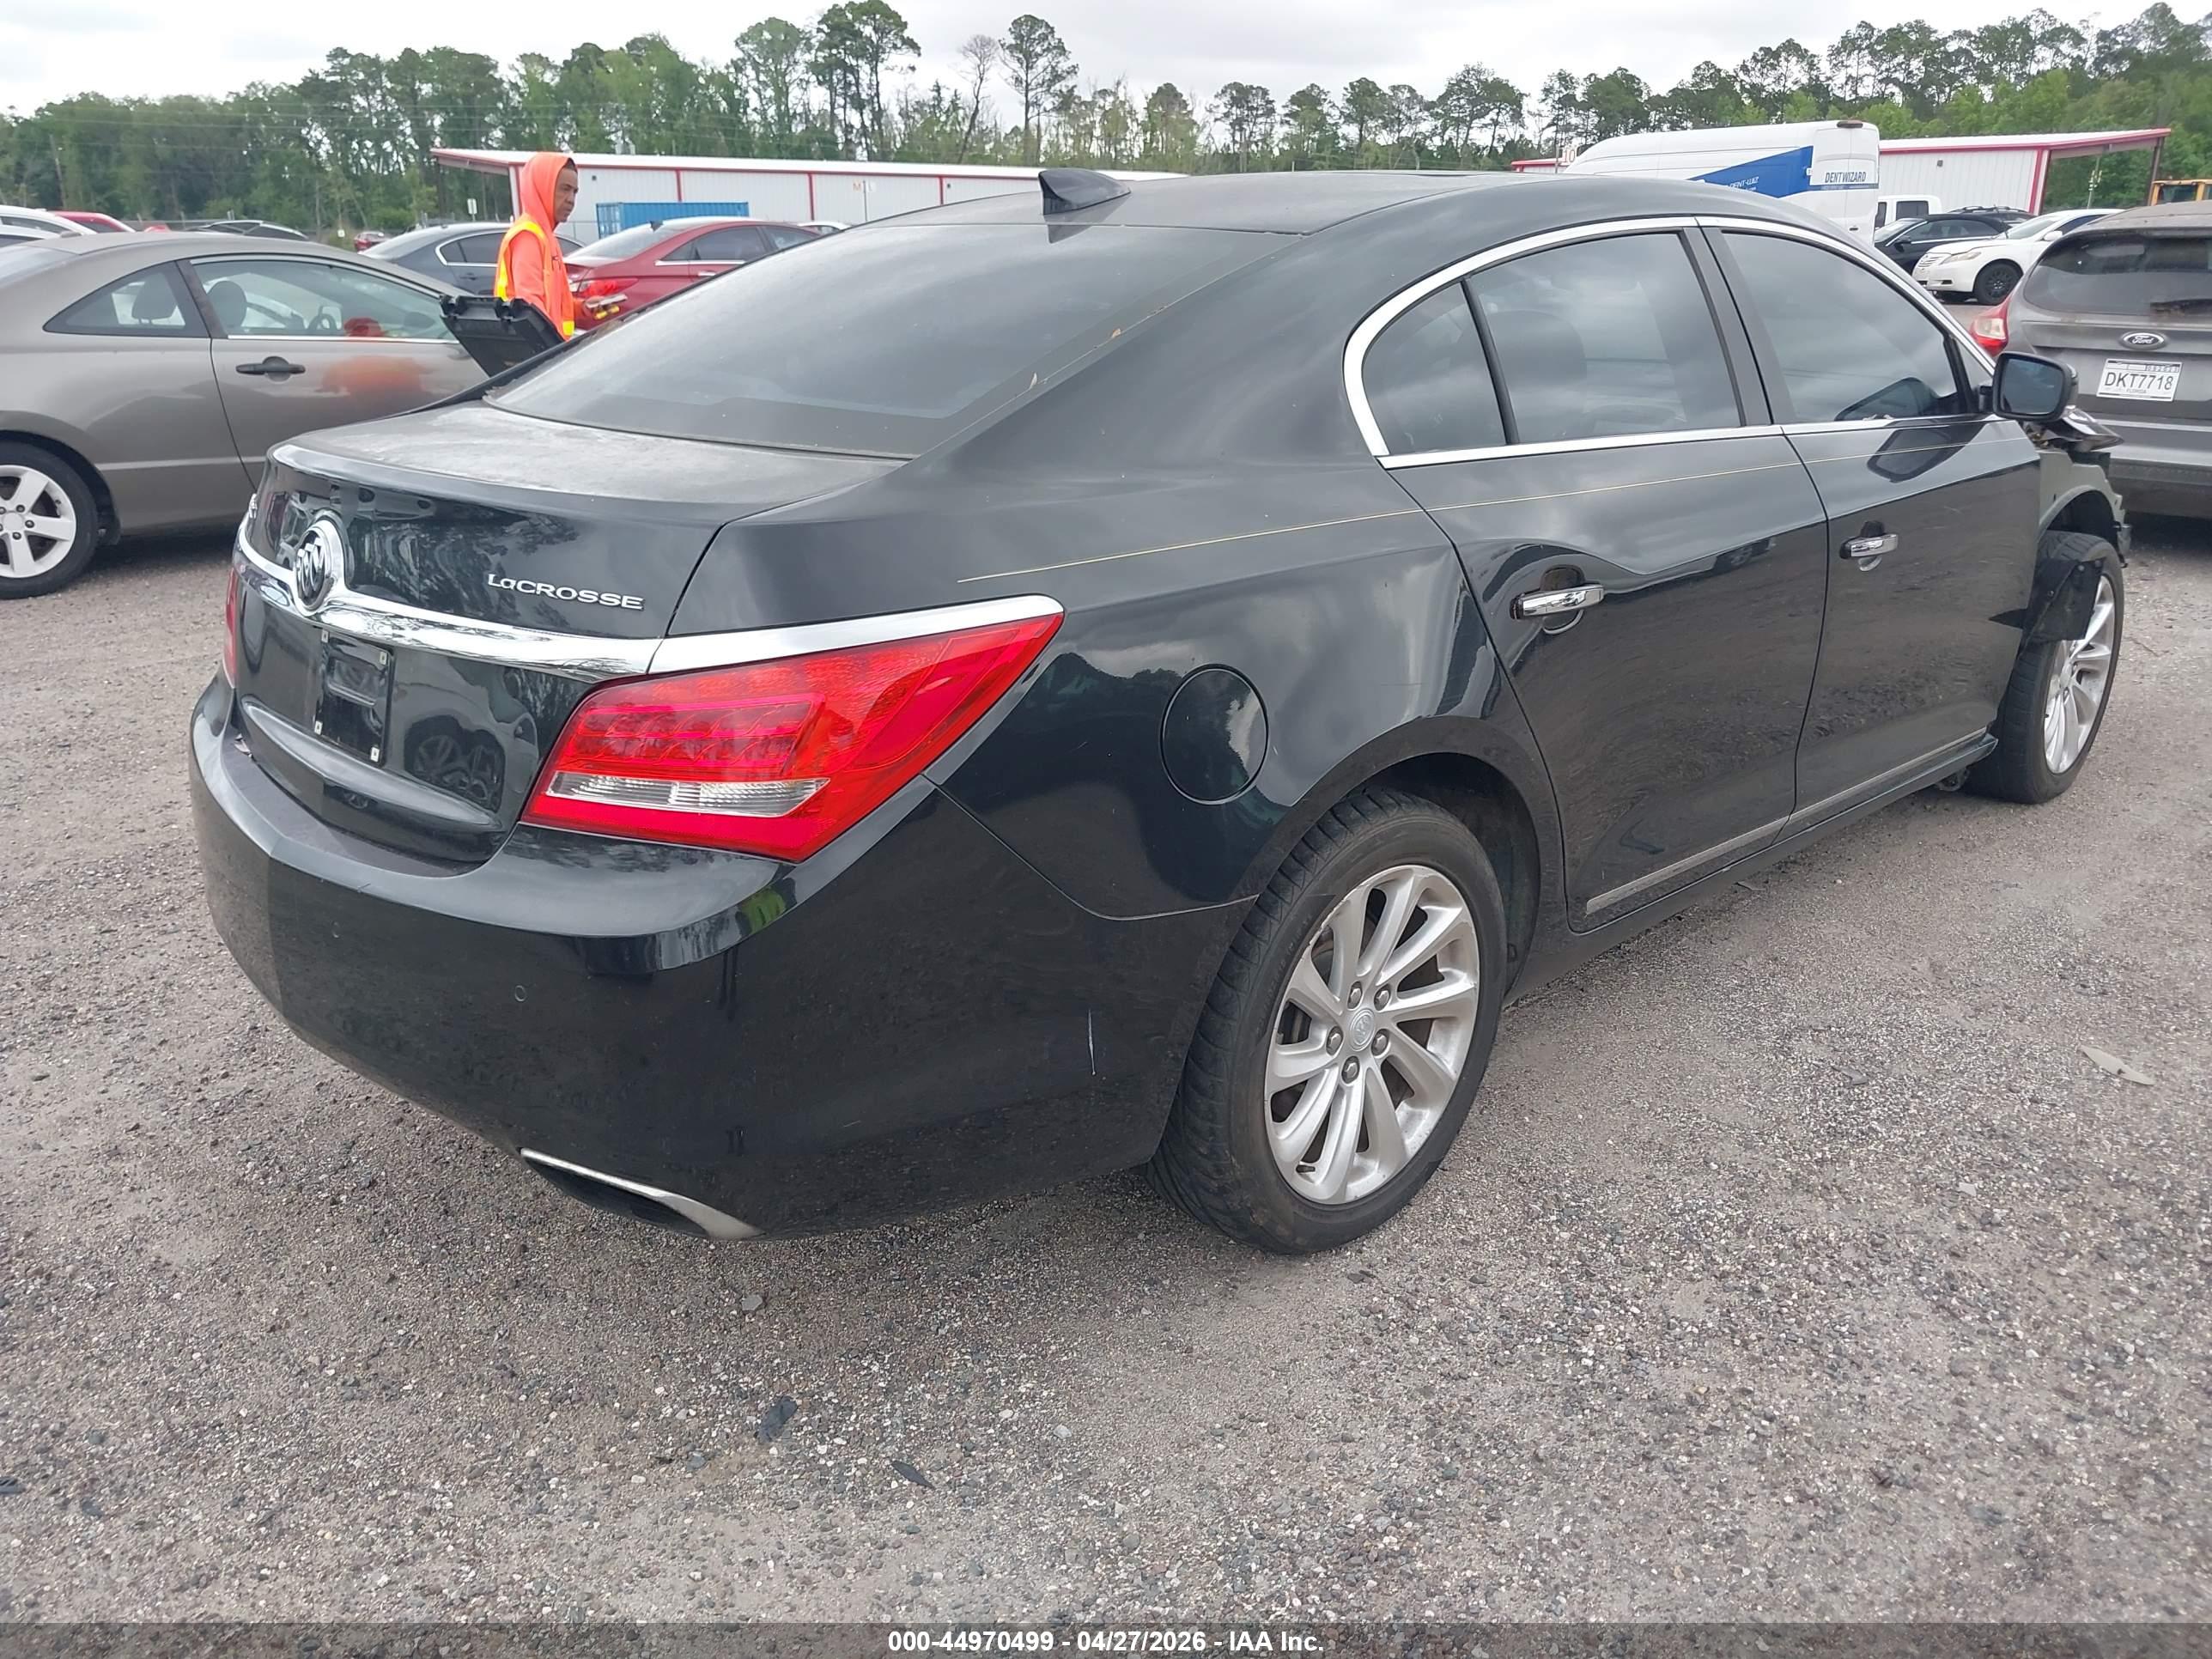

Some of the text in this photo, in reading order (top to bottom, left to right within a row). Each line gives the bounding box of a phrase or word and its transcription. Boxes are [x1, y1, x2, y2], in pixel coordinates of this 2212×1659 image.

[2131, 335, 2154, 344] Ford
[2104, 372, 2174, 391] DKT7718
[488, 574, 644, 611] LaCROSSE
